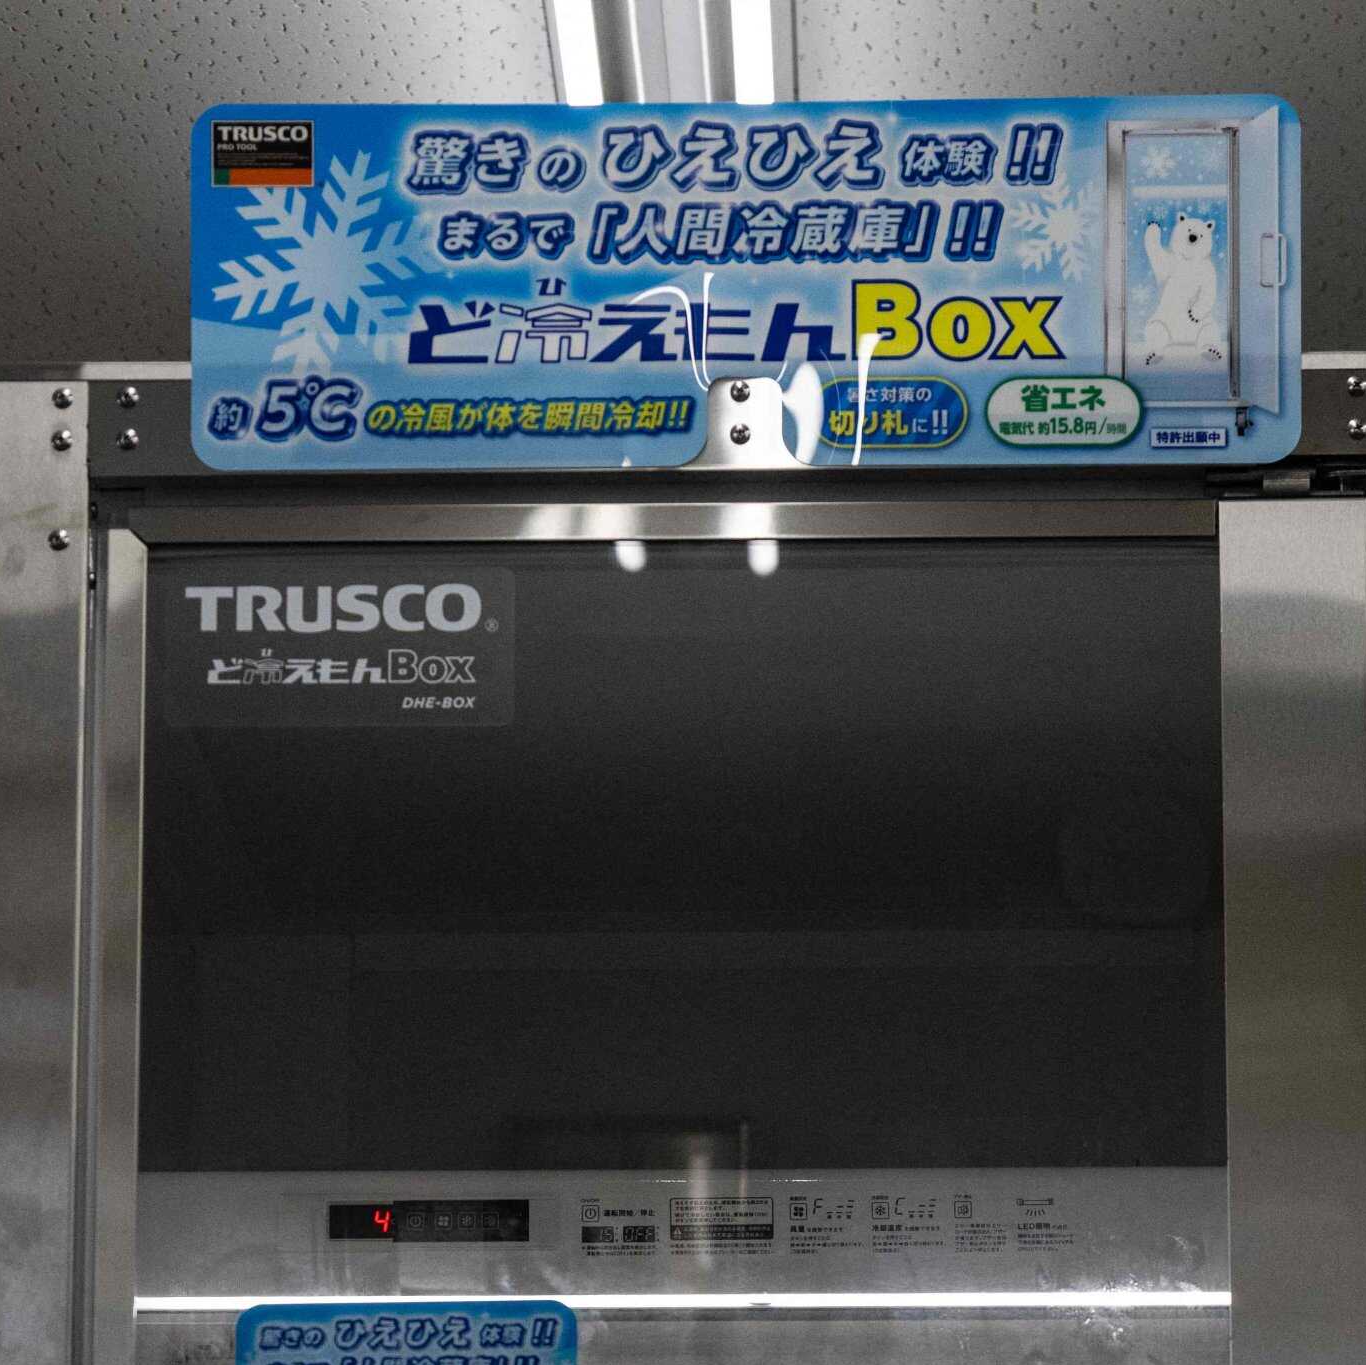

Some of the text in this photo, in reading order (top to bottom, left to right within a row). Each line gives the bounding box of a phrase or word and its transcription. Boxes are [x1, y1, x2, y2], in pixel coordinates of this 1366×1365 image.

[217, 125, 309, 142] TRUSCO
[1021, 384, 1107, 412] 省エネ
[1156, 431, 1222, 444] 特許出願中
[185, 583, 482, 633] TRUSCO
[402, 696, 476, 709] DHE-BOX
[373, 1209, 391, 1233] 4
